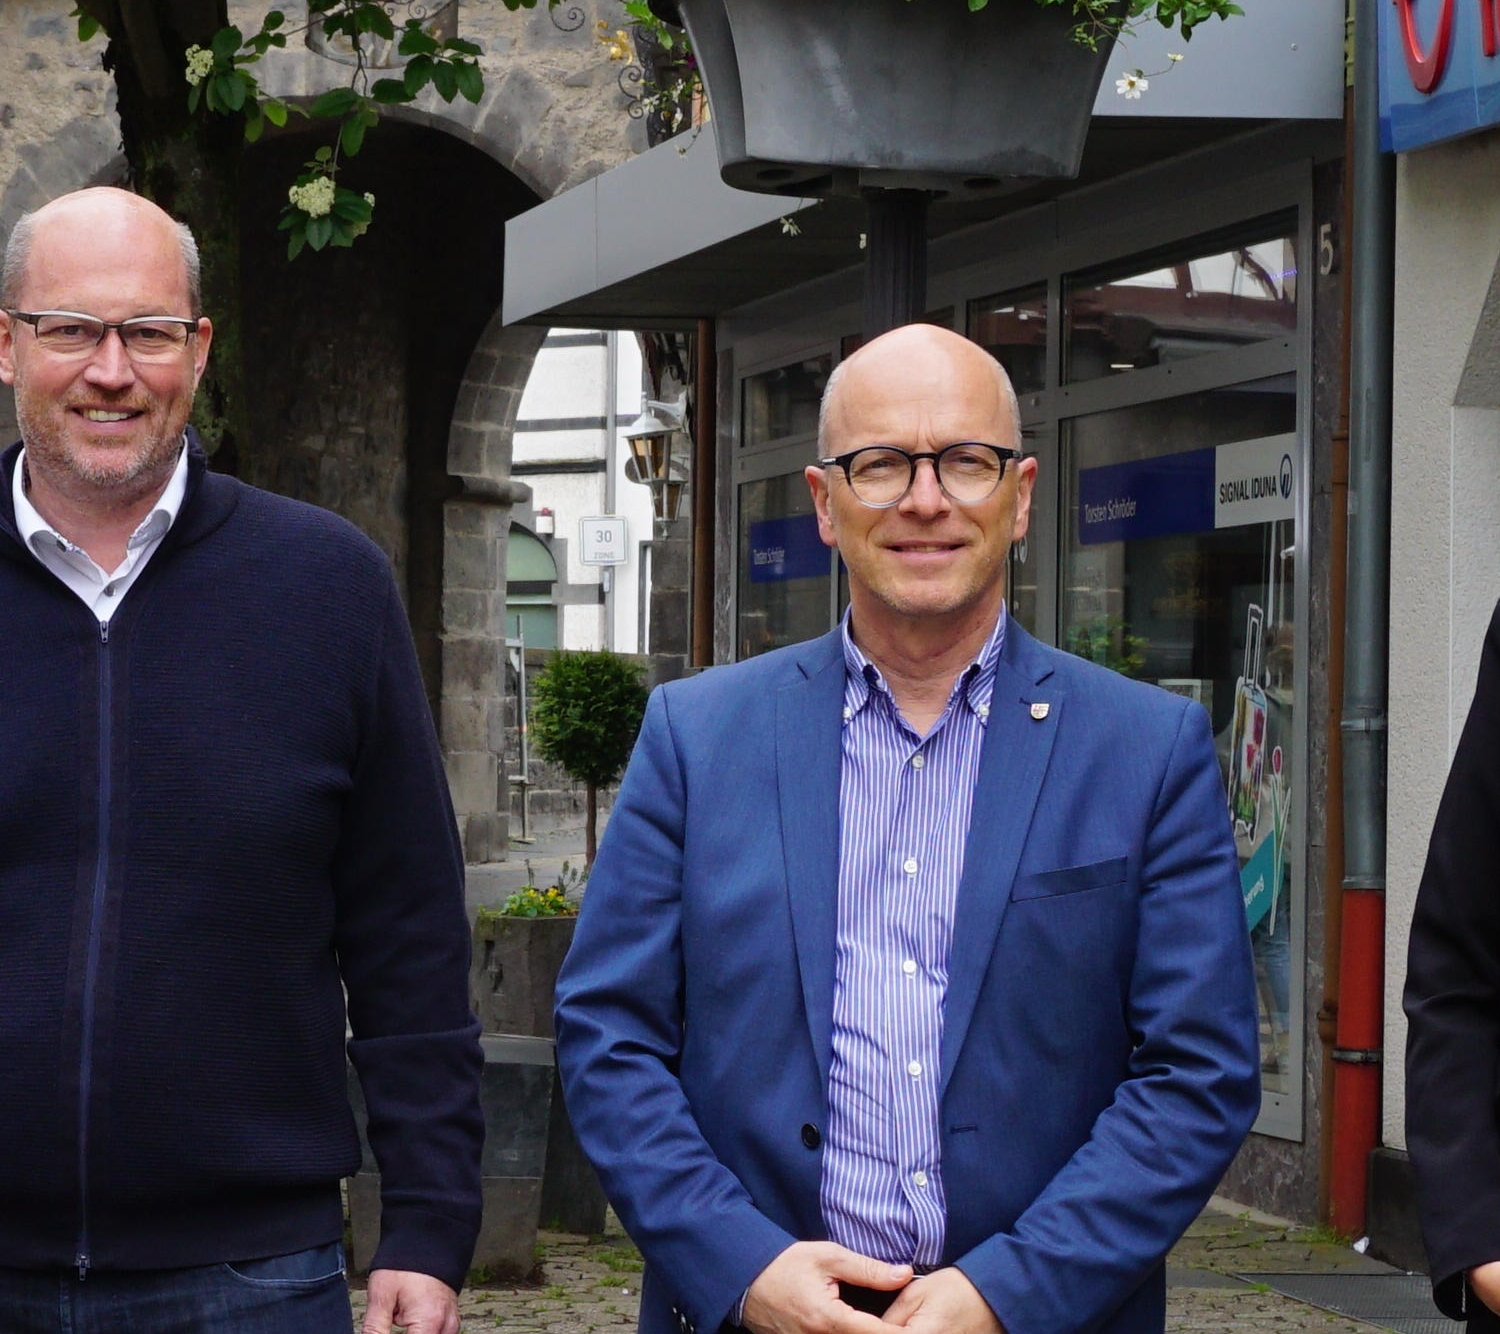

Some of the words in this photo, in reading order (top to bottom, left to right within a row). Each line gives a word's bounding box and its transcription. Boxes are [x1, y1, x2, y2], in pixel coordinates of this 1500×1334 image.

[1319, 223, 1334, 276] 5
[1219, 478, 1250, 505] SIGNAL
[1251, 474, 1278, 497] IDUNA
[1084, 502, 1107, 524] Torsten
[595, 529, 612, 543] 30
